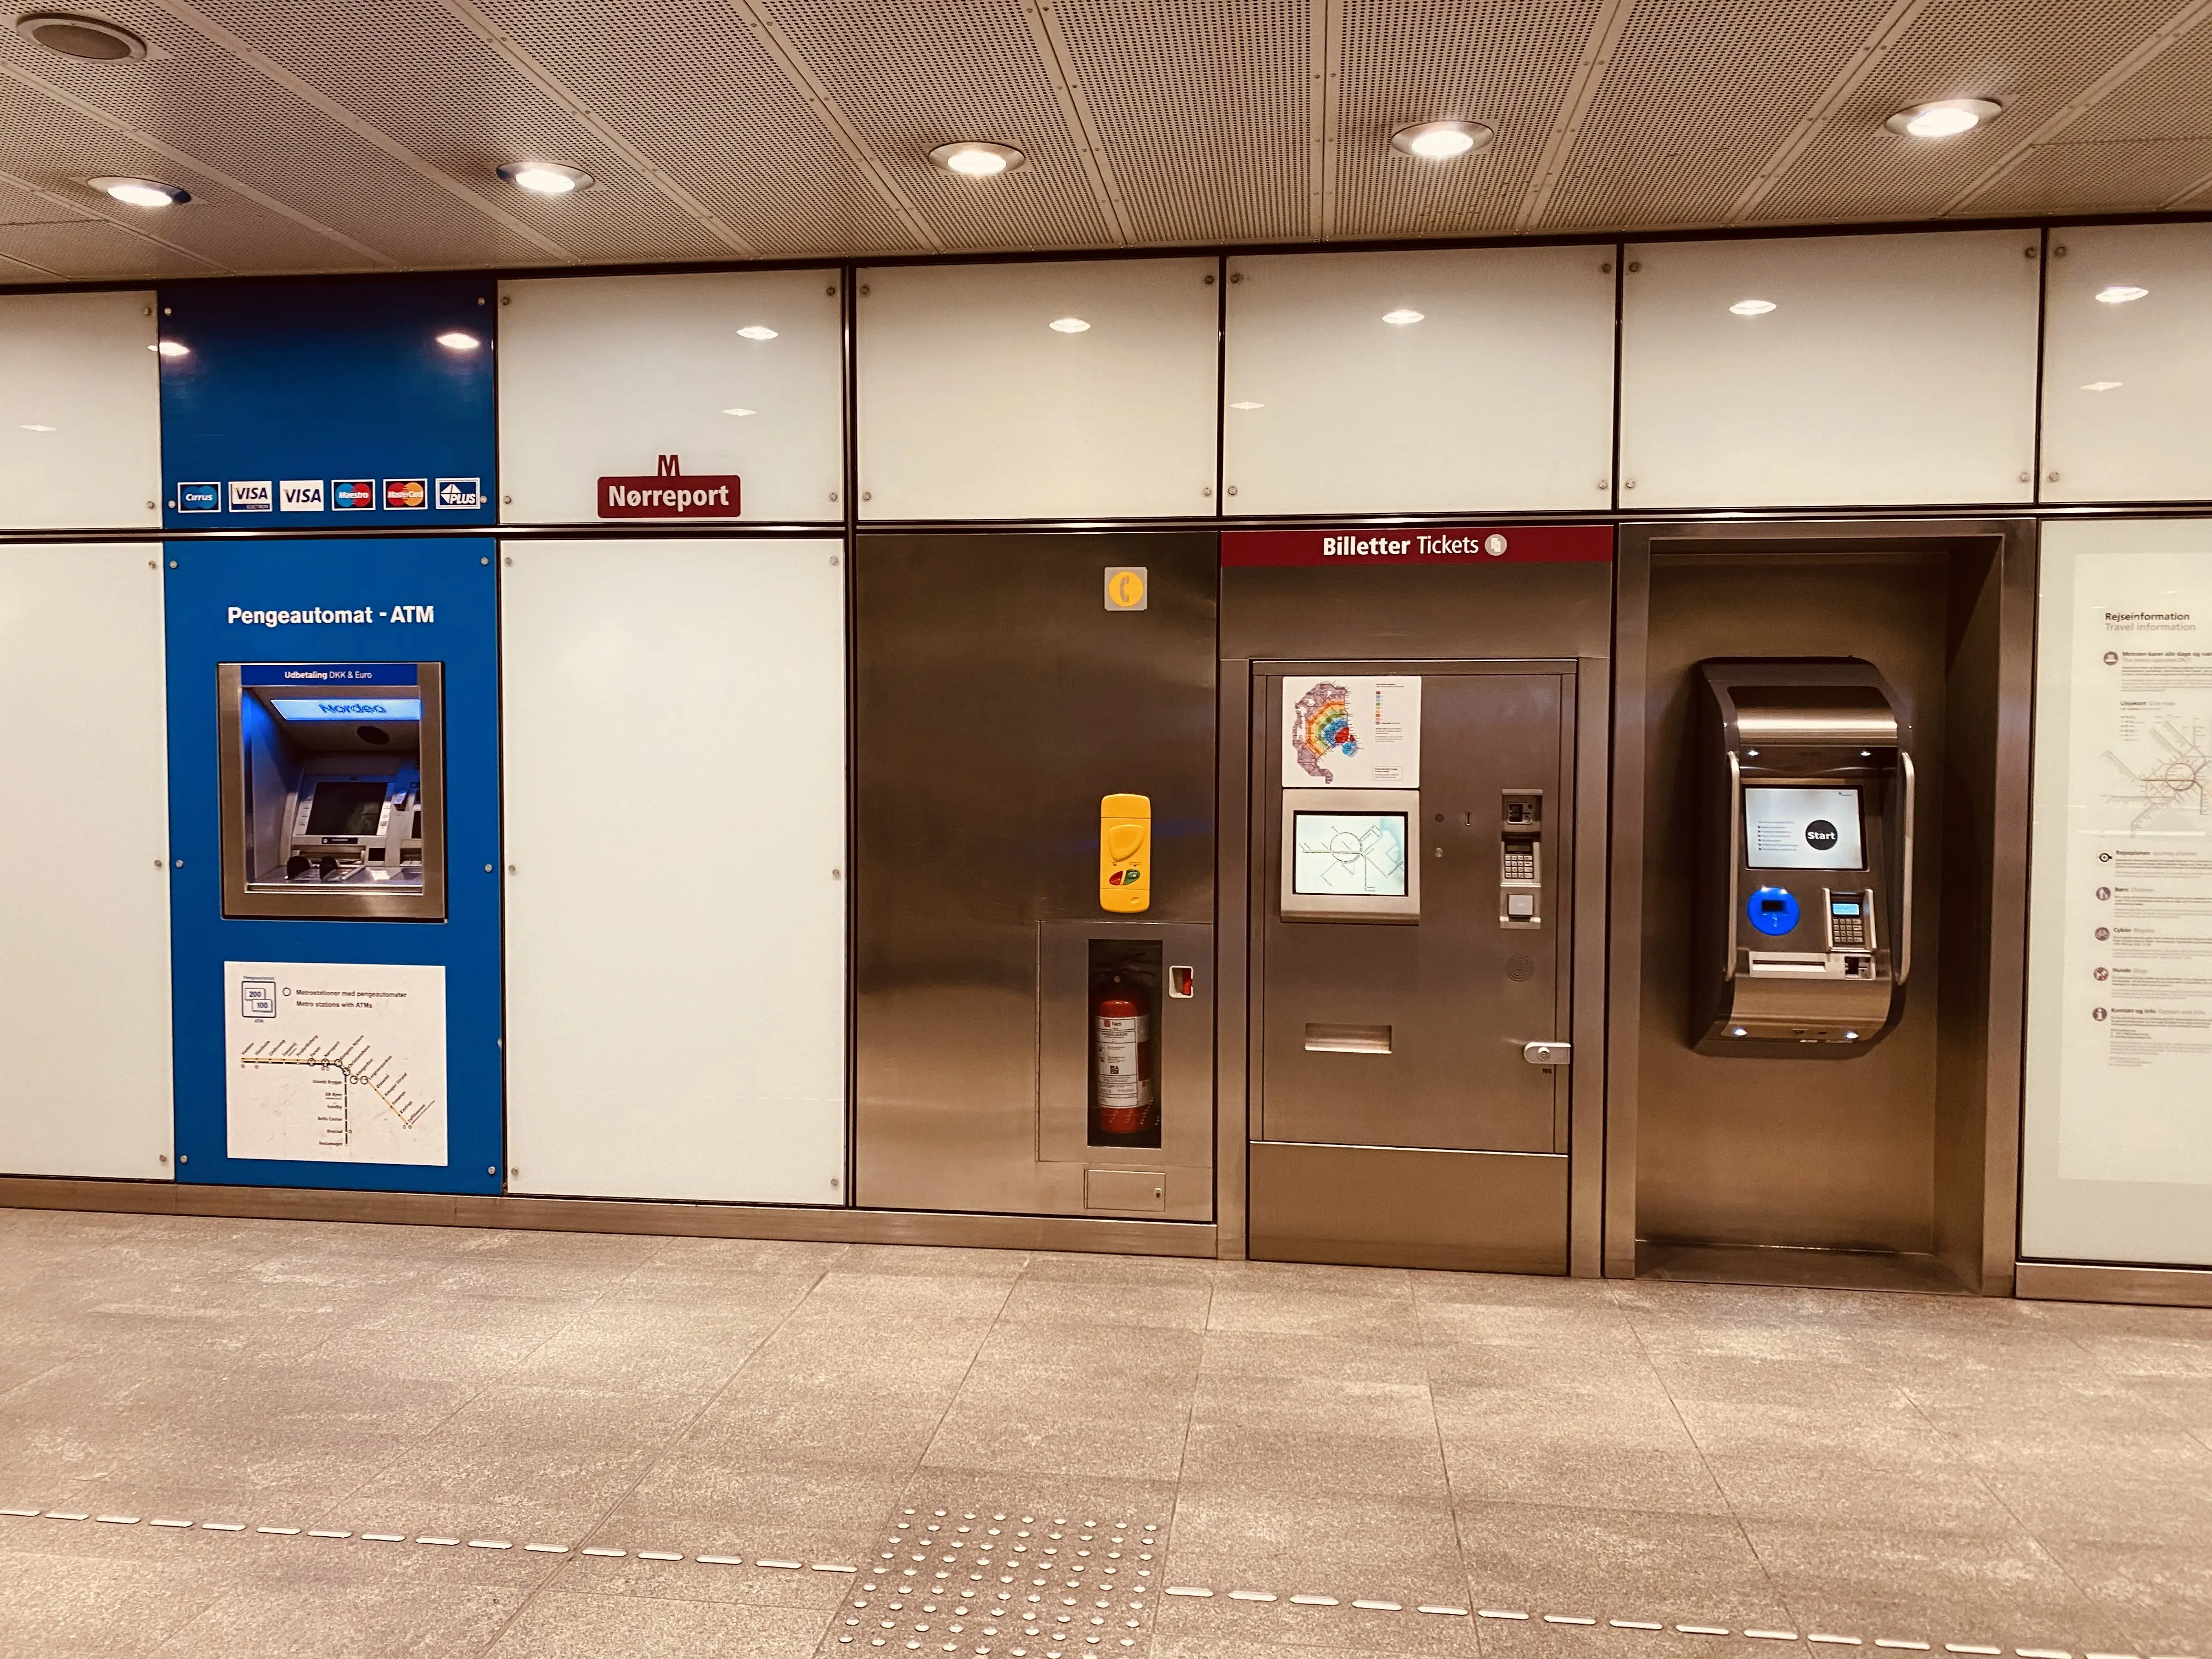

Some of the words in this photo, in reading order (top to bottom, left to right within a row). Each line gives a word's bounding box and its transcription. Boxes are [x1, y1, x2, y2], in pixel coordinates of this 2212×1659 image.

[234, 487, 268, 500] VISA
[283, 488, 321, 503] VISA
[449, 494, 476, 504] PLUS
[608, 485, 729, 512] Nørreport
[1323, 536, 1410, 556] Billetter
[1417, 534, 1479, 554] Tickets
[228, 606, 373, 628] Pengeautomat
[2105, 612, 2191, 622] Rejseinformation
[285, 672, 328, 680] Udbetaling
[318, 703, 387, 713] Nordea
[1807, 832, 1836, 840] Start
